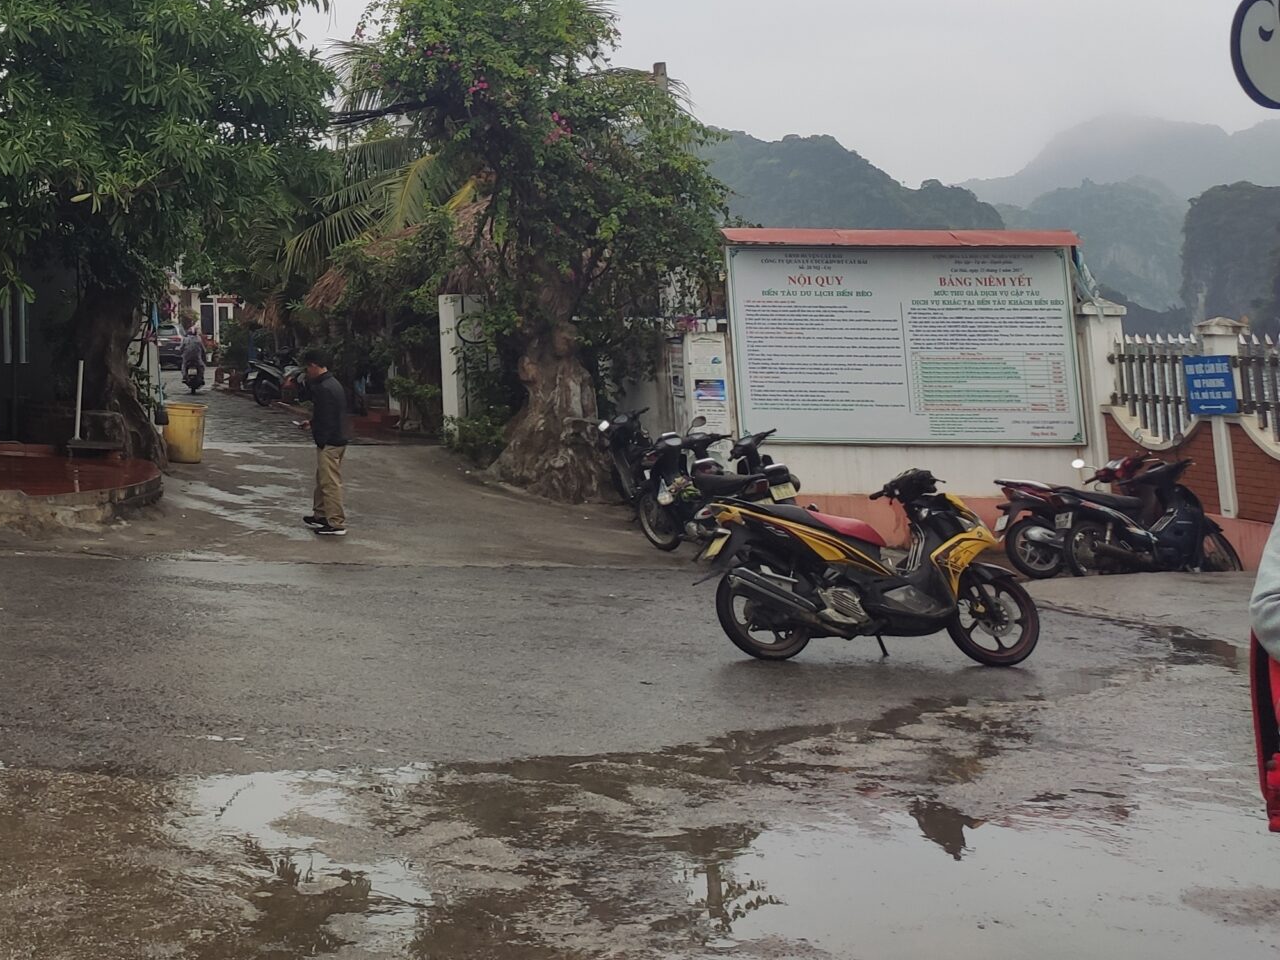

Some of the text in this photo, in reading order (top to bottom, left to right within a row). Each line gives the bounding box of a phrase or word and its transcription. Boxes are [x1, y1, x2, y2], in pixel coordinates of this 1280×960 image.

[788, 274, 843, 287] NỘI QUY
[939, 273, 1032, 287] BẢNG NIÊM YẾT
[762, 288, 779, 297] BẾN
[781, 289, 797, 297] TÀU
[814, 290, 834, 298] LỊCH
[836, 288, 853, 297] BẾN
[1202, 378, 1226, 388] PARKING
